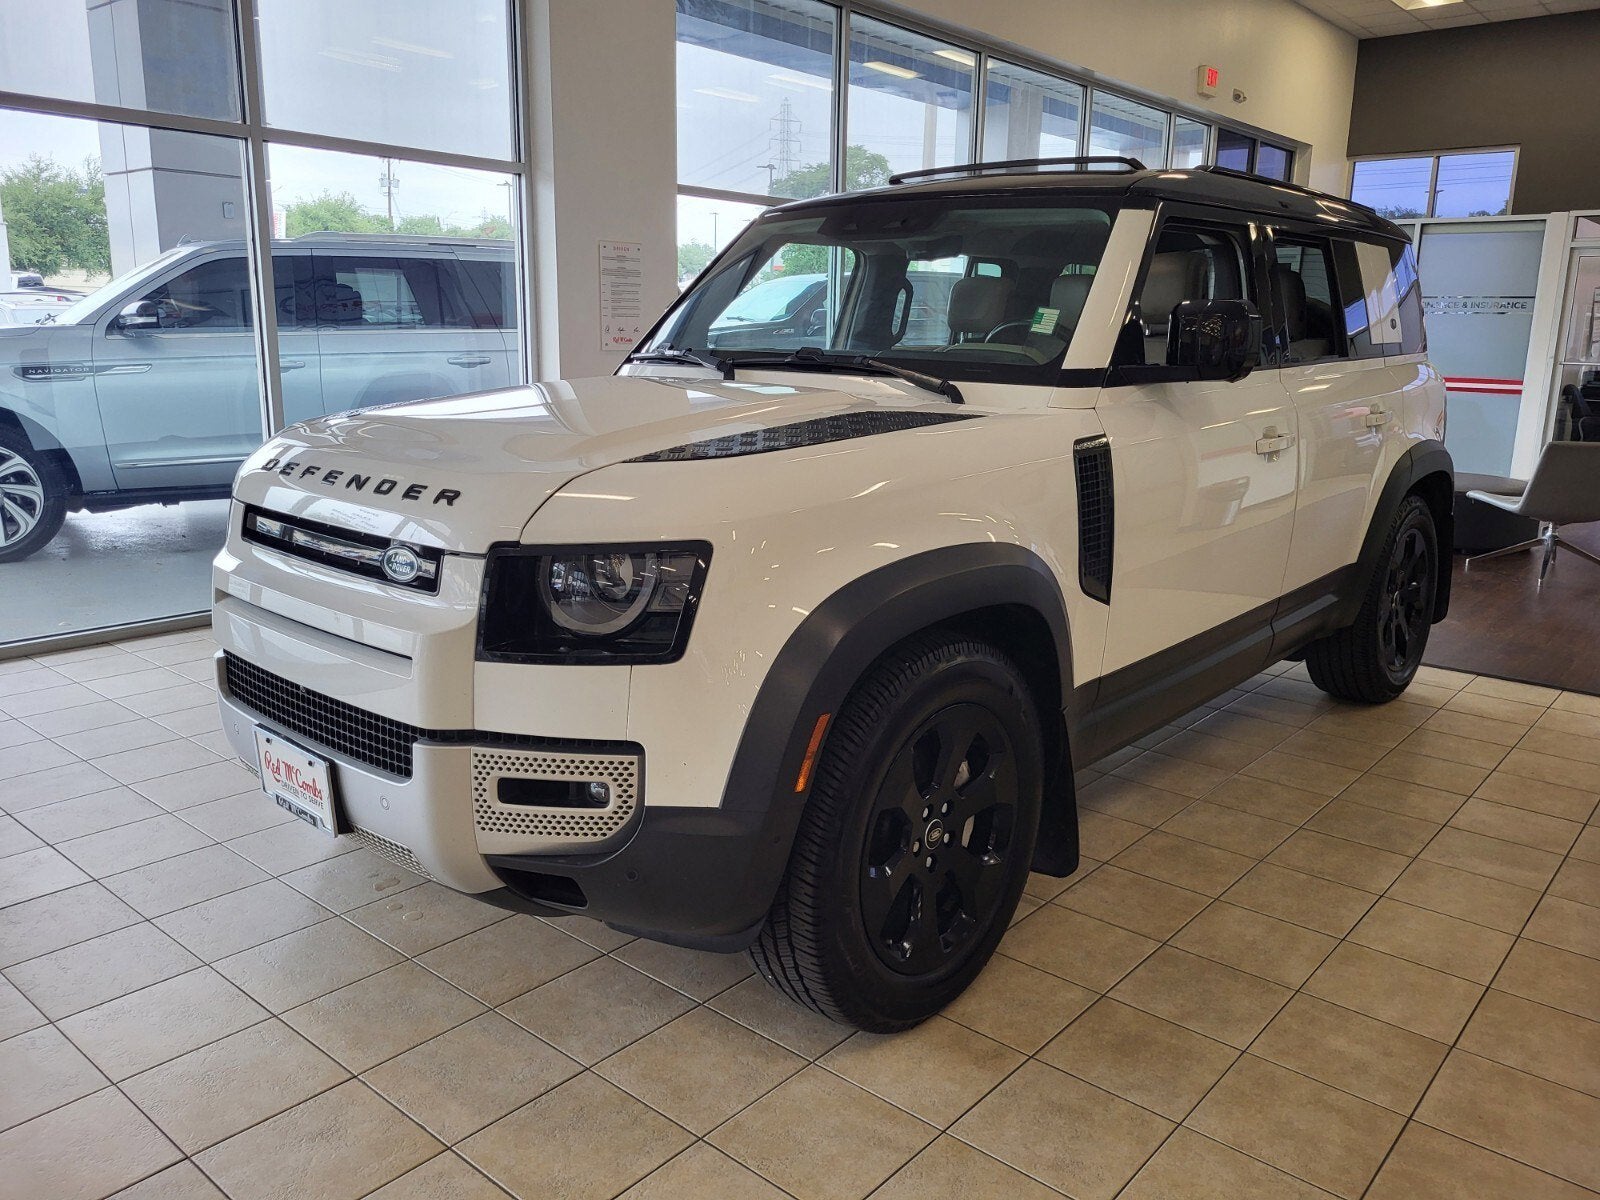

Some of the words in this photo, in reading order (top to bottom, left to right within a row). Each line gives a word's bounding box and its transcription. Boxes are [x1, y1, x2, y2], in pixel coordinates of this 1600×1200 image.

[1461, 301, 1468, 309] &
[1470, 301, 1527, 309] INSURANCE
[261, 458, 461, 506] DEFENDER
[391, 562, 411, 574] ROVER
[264, 751, 282, 782] Red
[282, 760, 323, 801] McCombs
